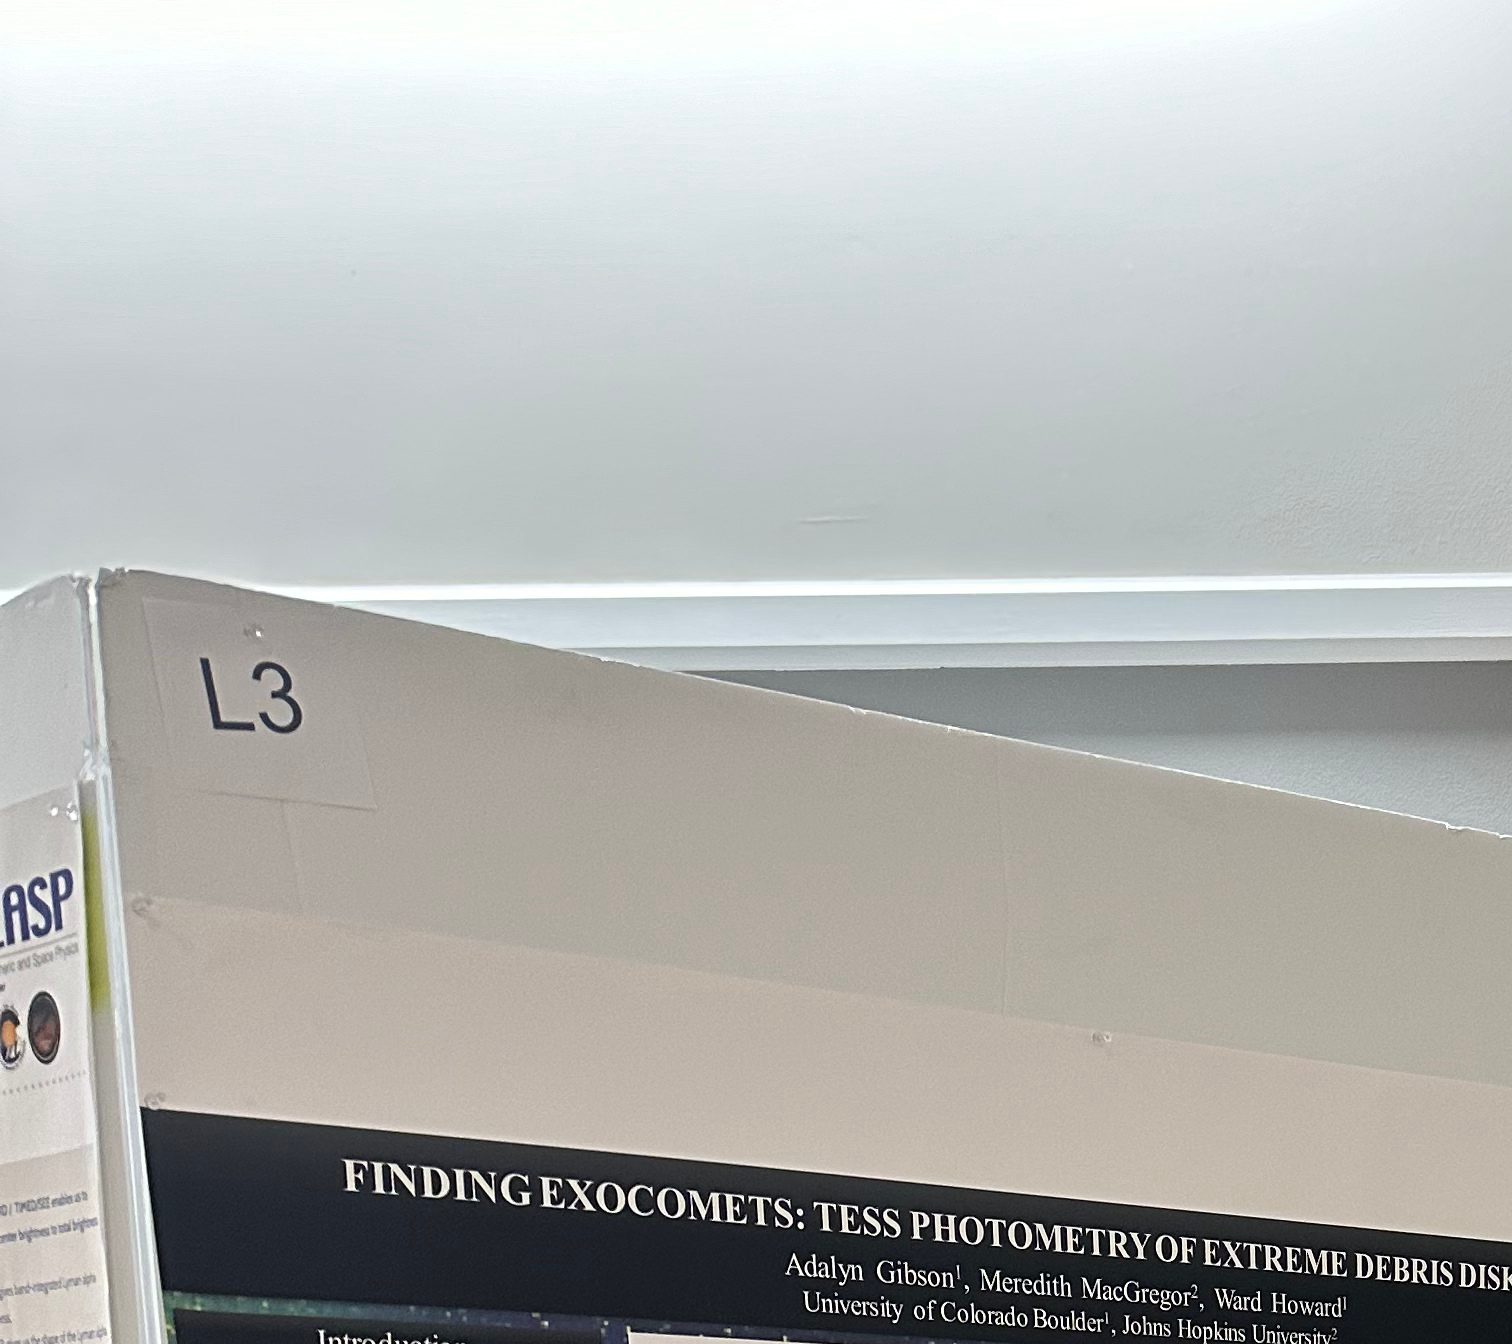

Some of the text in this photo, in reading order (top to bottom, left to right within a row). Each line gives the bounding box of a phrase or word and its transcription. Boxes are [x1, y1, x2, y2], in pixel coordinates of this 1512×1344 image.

[199, 657, 303, 735] L3
[0, 868, 74, 948] ASP
[341, 1158, 531, 1206] FINDING
[540, 1176, 804, 1229] EXOCOMETS:
[813, 1201, 901, 1238] TESS
[910, 1210, 1151, 1259] PHOTOMETRY
[1155, 1234, 1196, 1263] OF
[1202, 1238, 1347, 1277] EXTREME
[1354, 1252, 1453, 1286] DEBRIS
[785, 1252, 863, 1286] Adalyn
[979, 1268, 1072, 1297] Meredith
[1214, 1287, 1261, 1312] Ward
[802, 1290, 903, 1323] University
[913, 1299, 937, 1320] of
[940, 1301, 1028, 1327] Colorado
[1122, 1314, 1170, 1337] Johns
[1177, 1318, 1245, 1344] Hopkins
